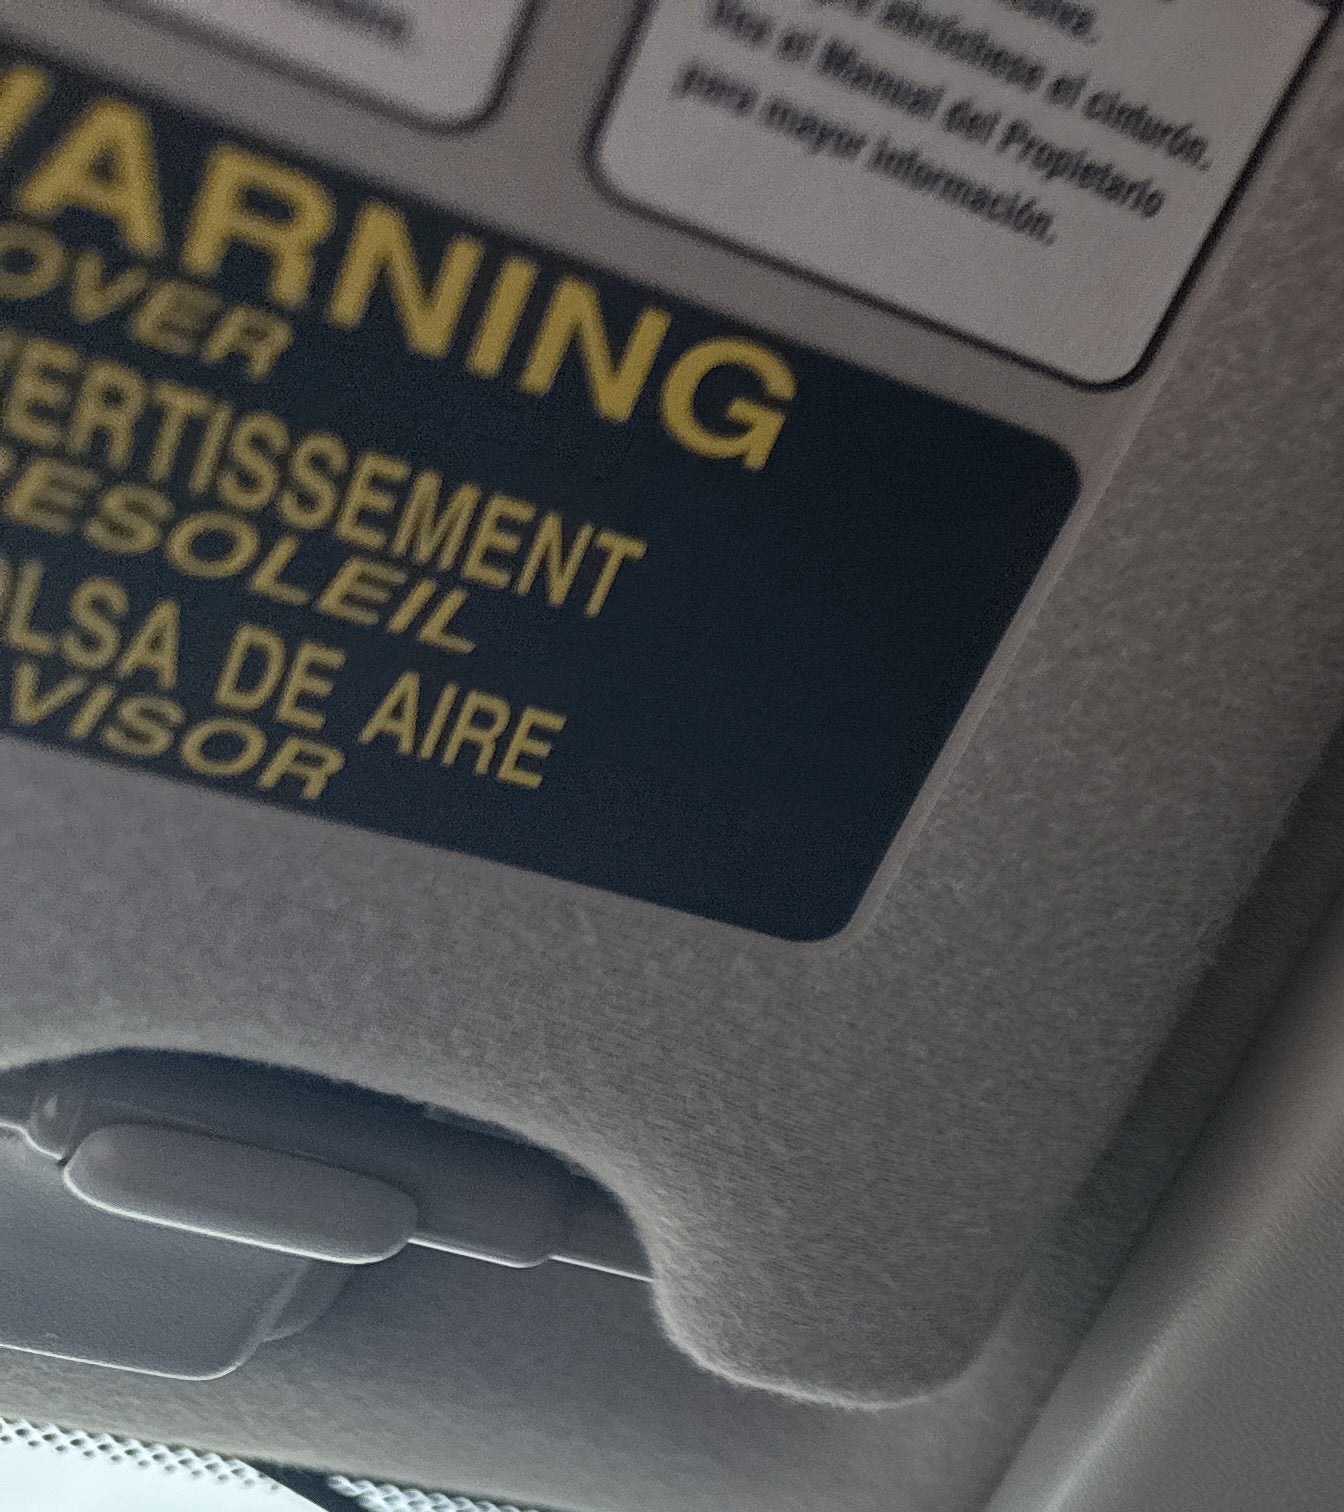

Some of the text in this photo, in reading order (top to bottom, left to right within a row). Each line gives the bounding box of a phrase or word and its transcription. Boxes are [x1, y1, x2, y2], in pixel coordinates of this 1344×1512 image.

[763, 96, 867, 162] mayor
[867, 134, 1058, 246] información.
[817, 37, 946, 121] Manual
[942, 99, 1001, 146] del
[998, 118, 1166, 218] Propietario
[0, 328, 648, 618] ERTISSEMENT
[0, 446, 476, 655] ESOLEIL
[0, 554, 568, 790] LSA DE AIRE
[8, 660, 346, 802] VISOR
